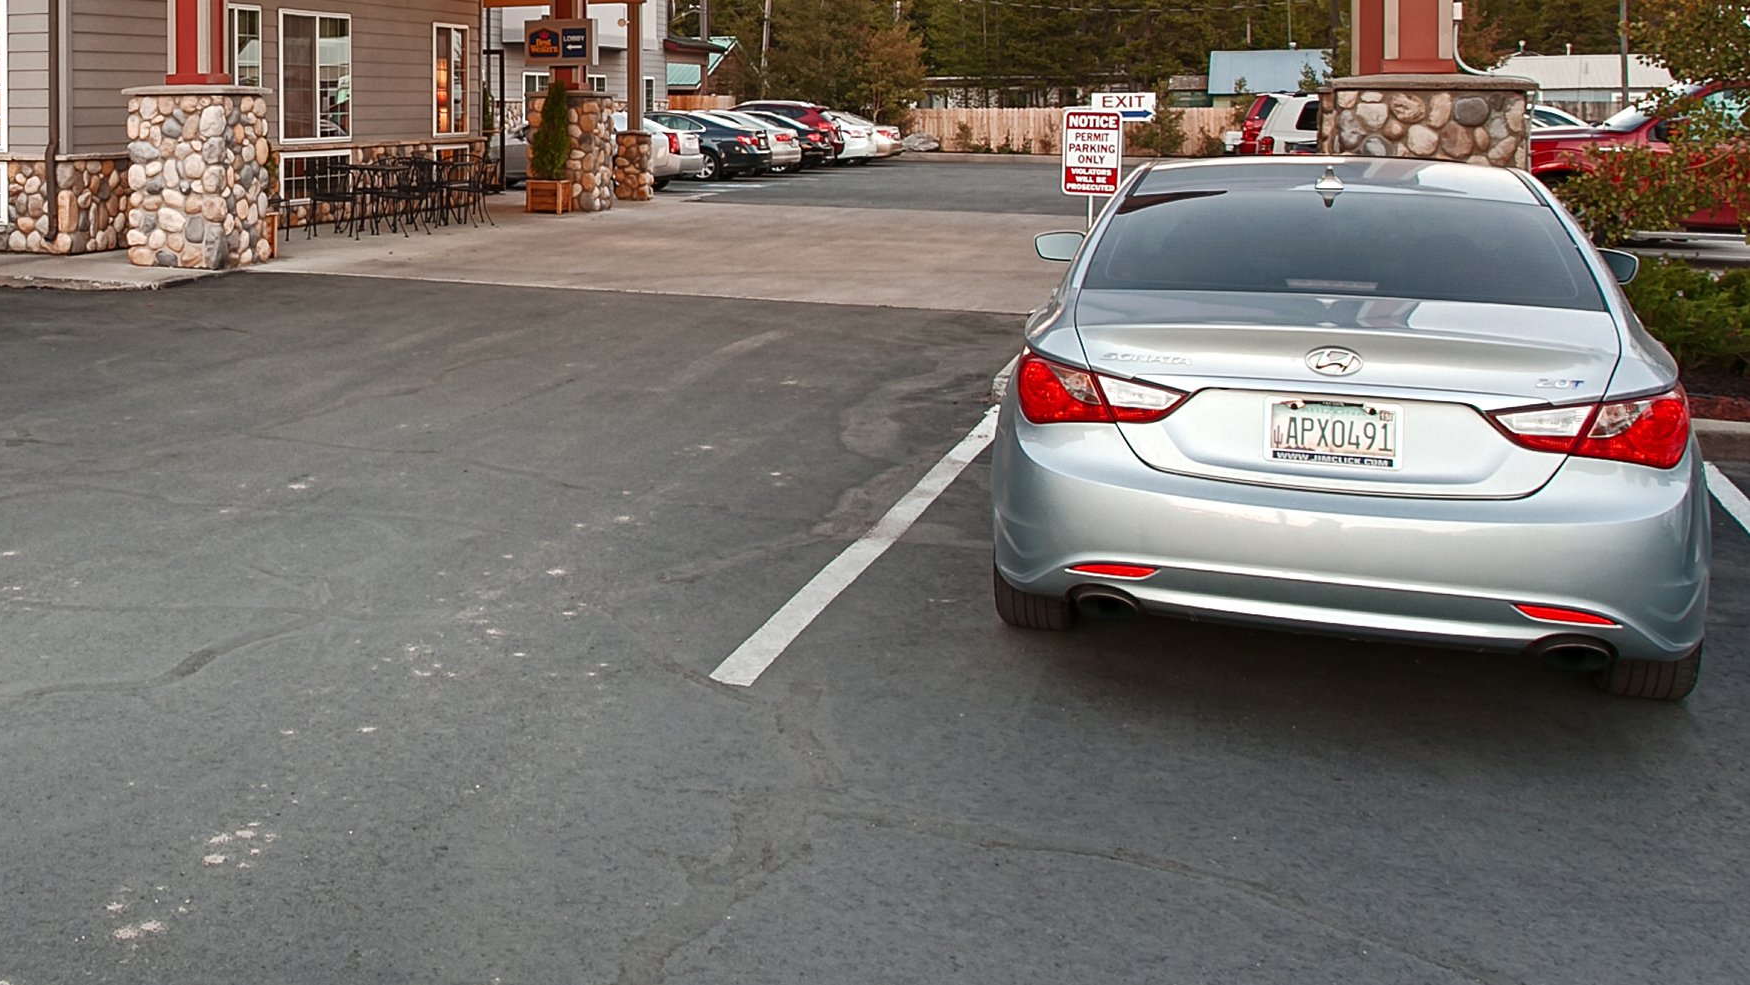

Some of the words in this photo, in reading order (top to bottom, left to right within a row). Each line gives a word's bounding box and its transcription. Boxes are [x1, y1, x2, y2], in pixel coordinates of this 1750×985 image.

[1102, 95, 1145, 108] EXIT
[1068, 115, 1118, 128] NOTICE
[1074, 132, 1110, 142] PERMIT
[1068, 143, 1116, 154] PARKING
[1077, 154, 1105, 165] ONLY
[1071, 168, 1112, 176] VIOLATORS
[1075, 176, 1094, 184] WILL
[1096, 176, 1107, 184] BE
[1066, 183, 1116, 192] PROSECUTED
[1100, 352, 1192, 366] SONATA
[1285, 416, 1393, 452] APX0491
[1276, 451, 1389, 467] WWW.JIMCLICK.COM
